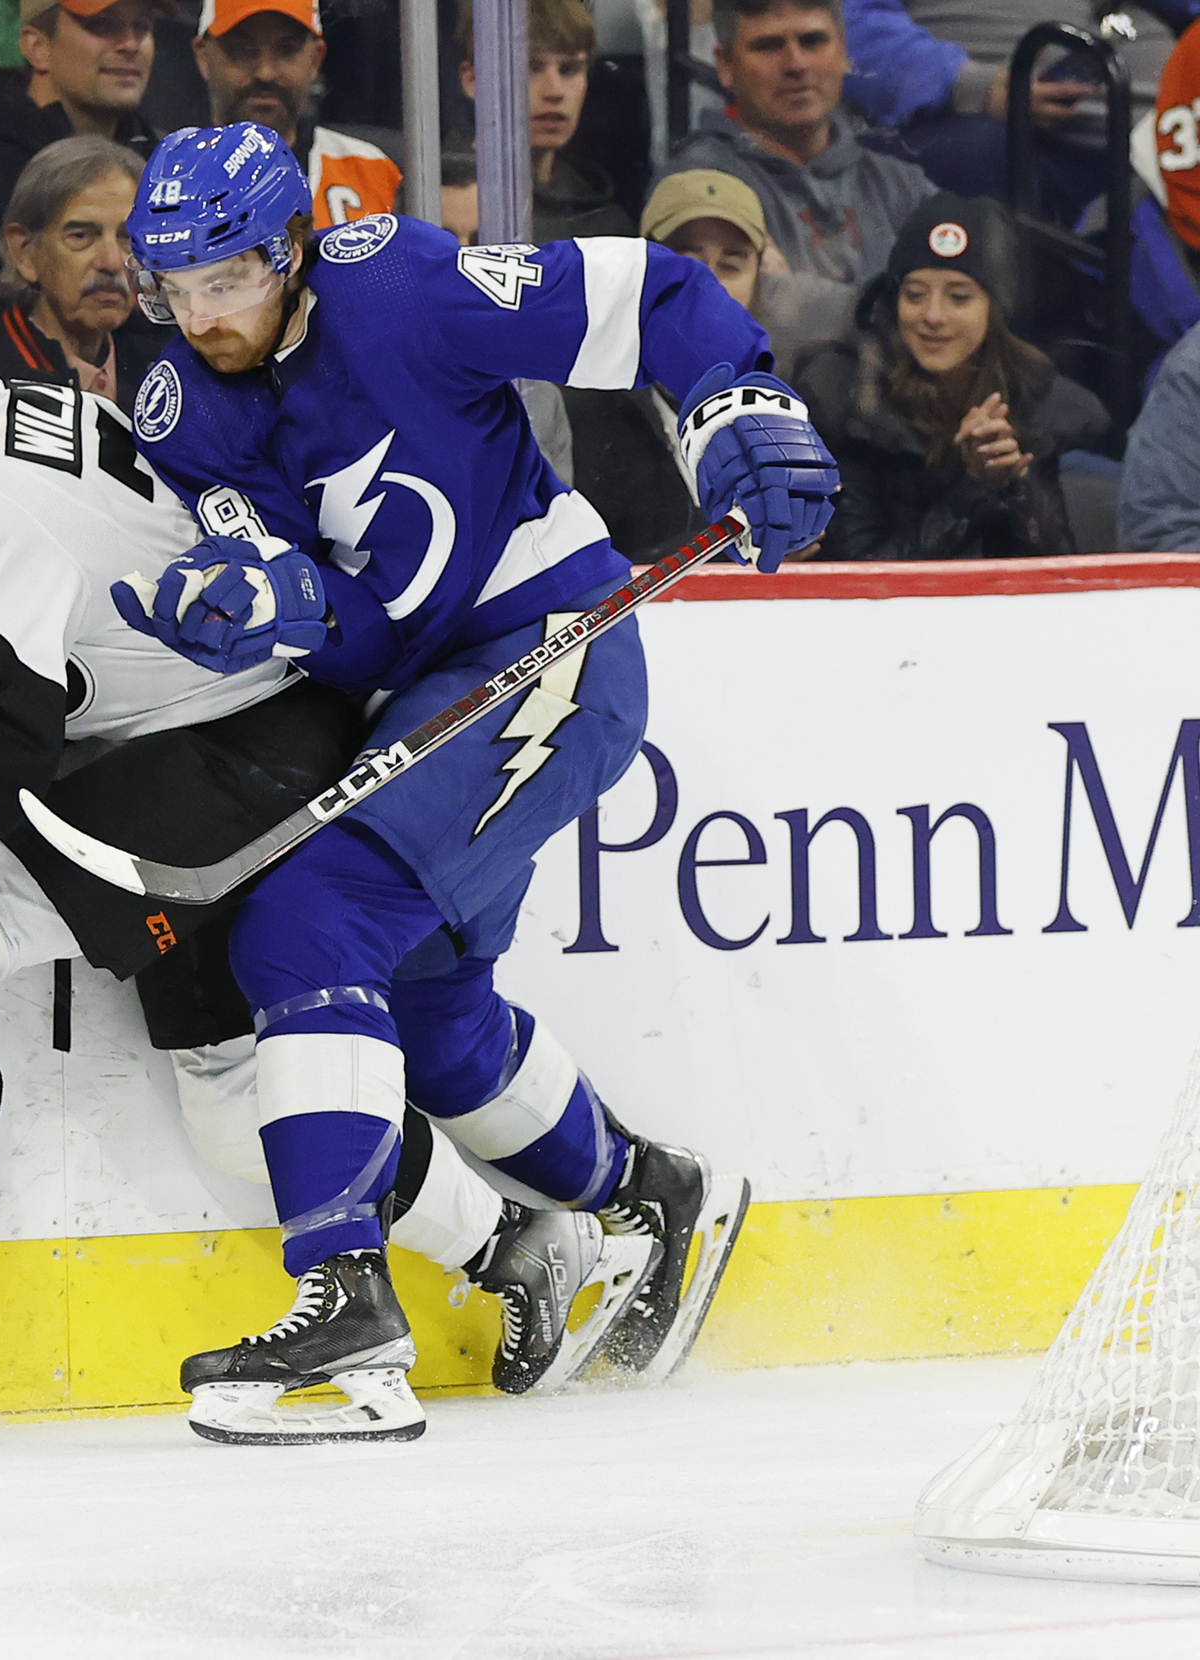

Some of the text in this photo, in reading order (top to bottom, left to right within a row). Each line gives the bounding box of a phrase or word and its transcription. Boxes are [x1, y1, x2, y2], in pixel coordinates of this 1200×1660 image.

[1159, 97, 1200, 172] 3
[149, 180, 182, 206] 48
[145, 229, 191, 244] CCM
[300, 567, 317, 602] CCM
[485, 621, 588, 700] JETSPEED
[582, 611, 602, 628] FTS
[307, 740, 414, 822] CCM
[562, 718, 1200, 954] Penn M
